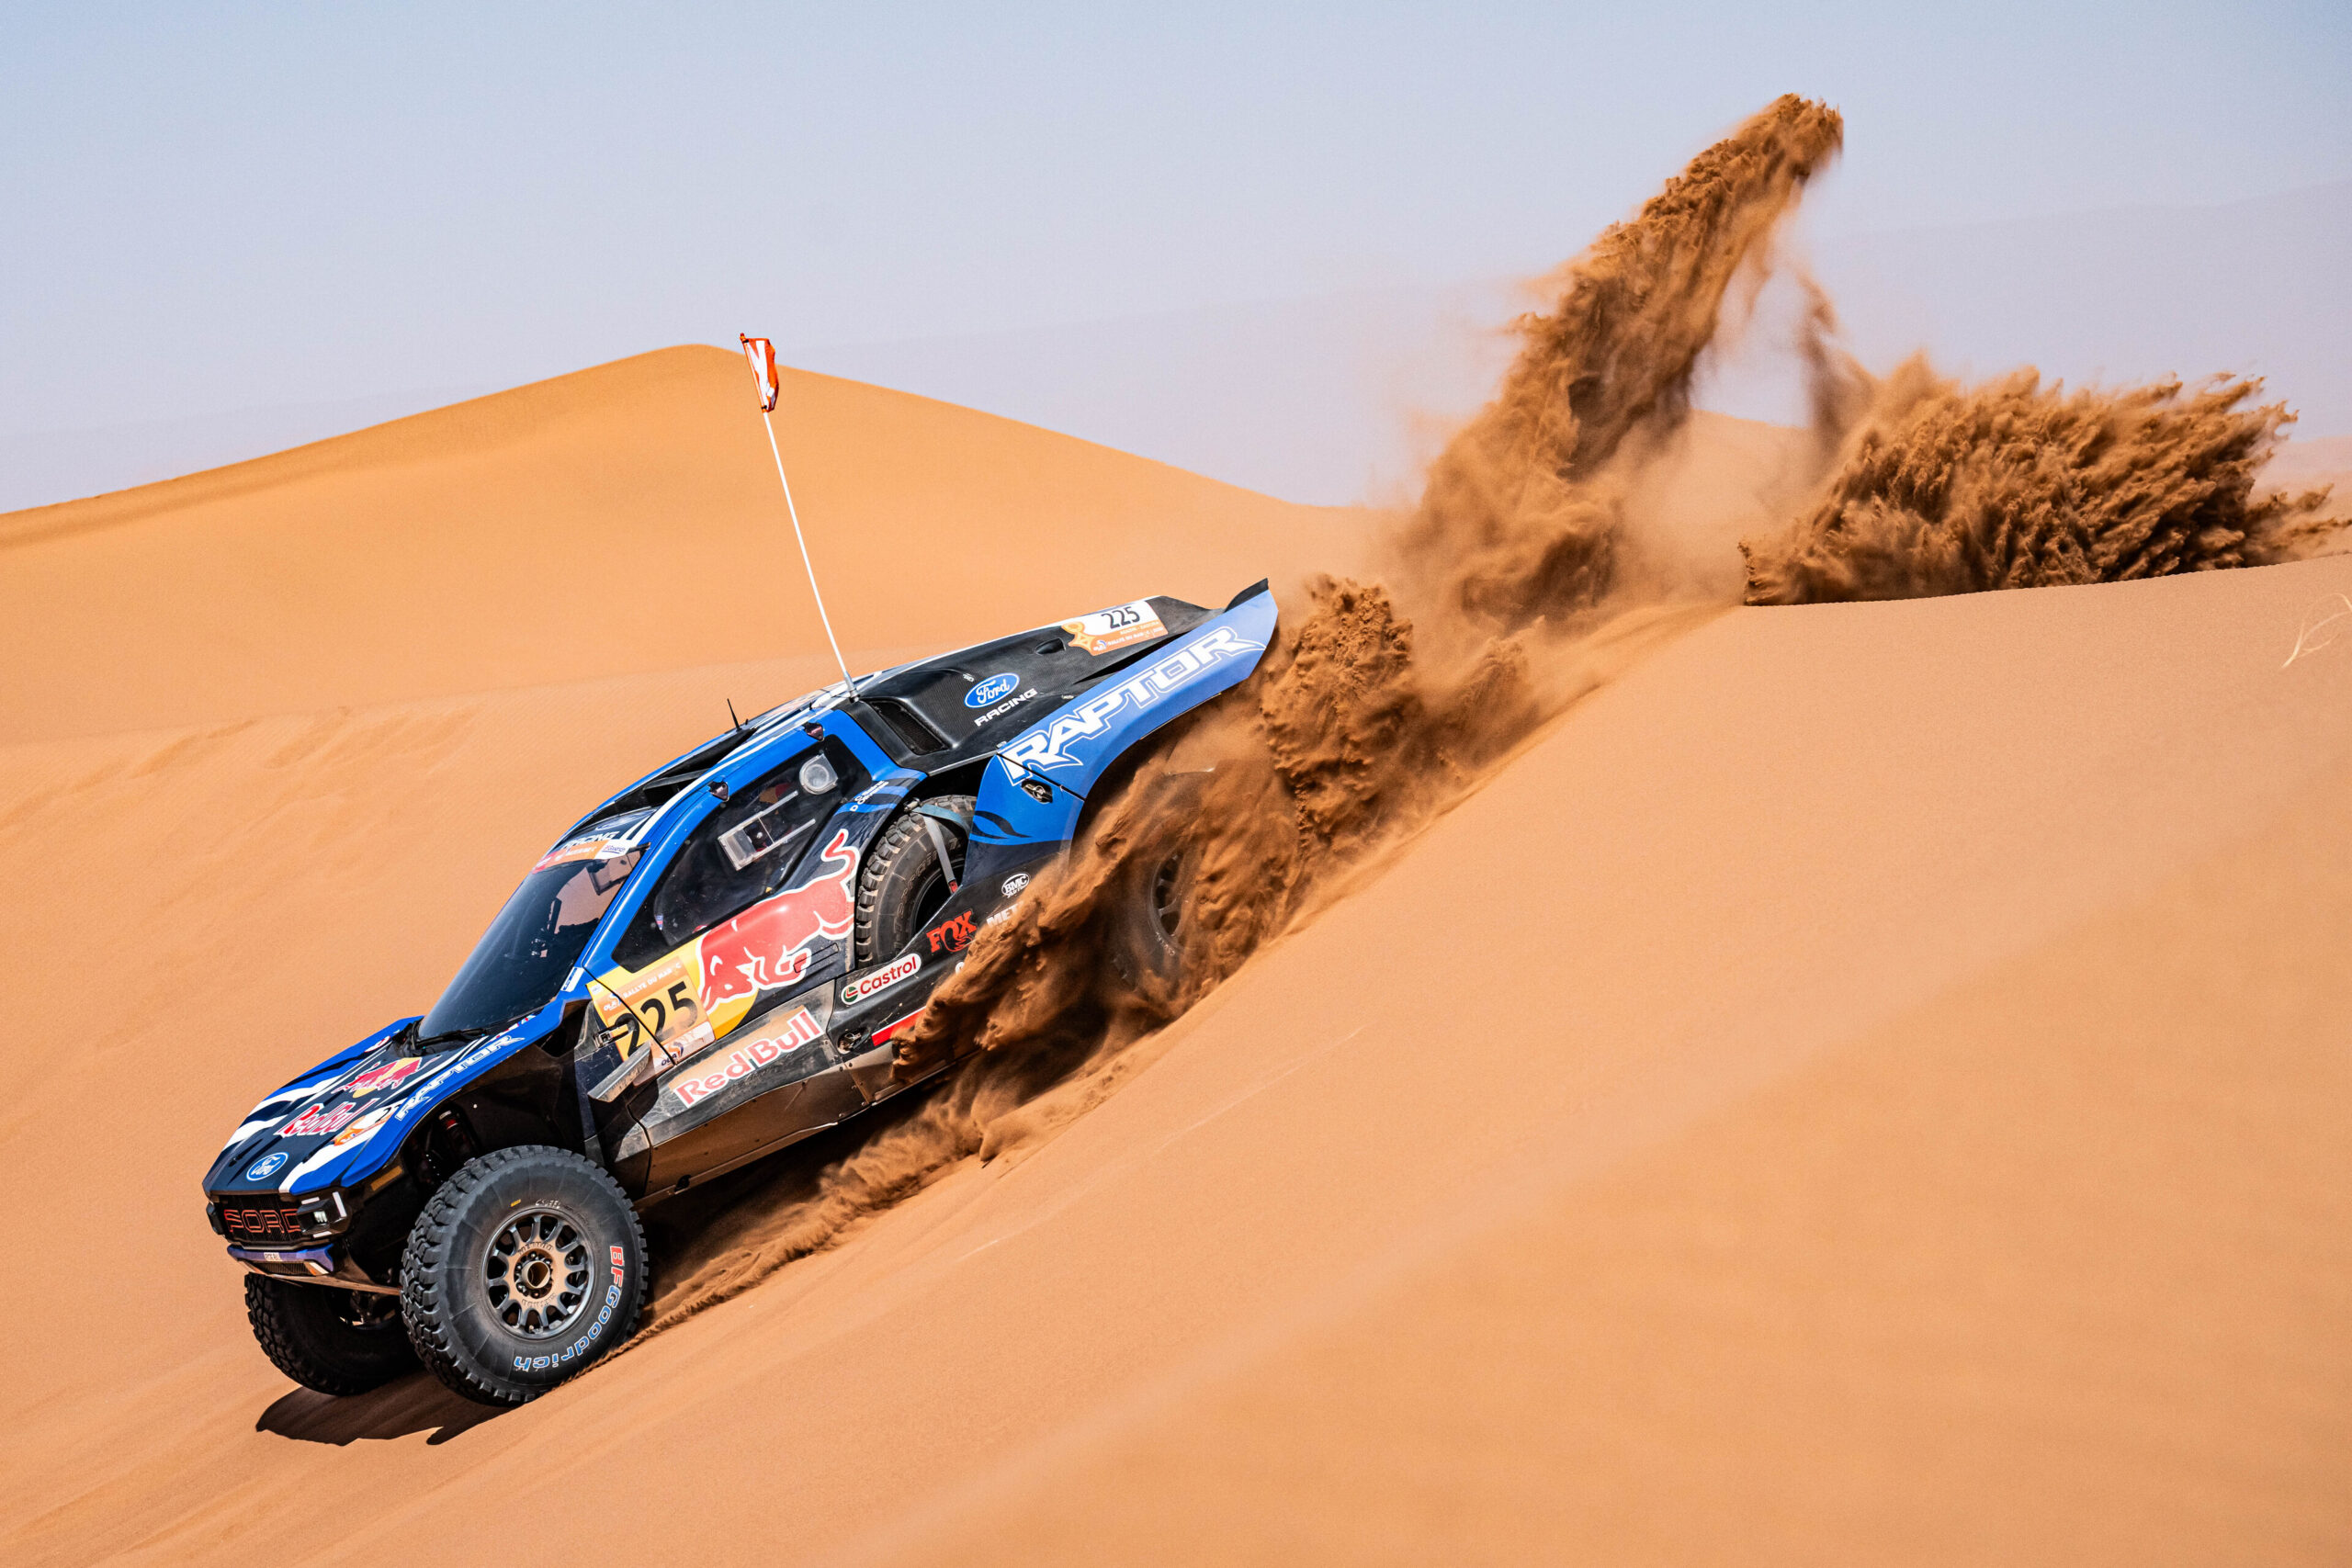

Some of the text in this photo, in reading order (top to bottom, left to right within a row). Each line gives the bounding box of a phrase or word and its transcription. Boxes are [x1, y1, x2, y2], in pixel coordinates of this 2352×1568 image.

[1100, 606, 1141, 629] 225
[974, 687, 1038, 727] RACING
[975, 678, 1011, 705] Ford
[998, 626, 1266, 786] RAPTOR
[1004, 875, 1029, 895] BMC
[925, 910, 978, 953] FOX
[986, 901, 1026, 928] MET
[623, 982, 648, 998] RALLYE
[647, 975, 658, 986] DU
[860, 956, 917, 995] Castrol
[614, 980, 698, 1058] 225
[674, 1009, 824, 1108] Red Bull
[394, 1035, 526, 1122] RAPTOR
[273, 1100, 349, 1138] Red
[514, 1246, 625, 1371] BFGoodrich
